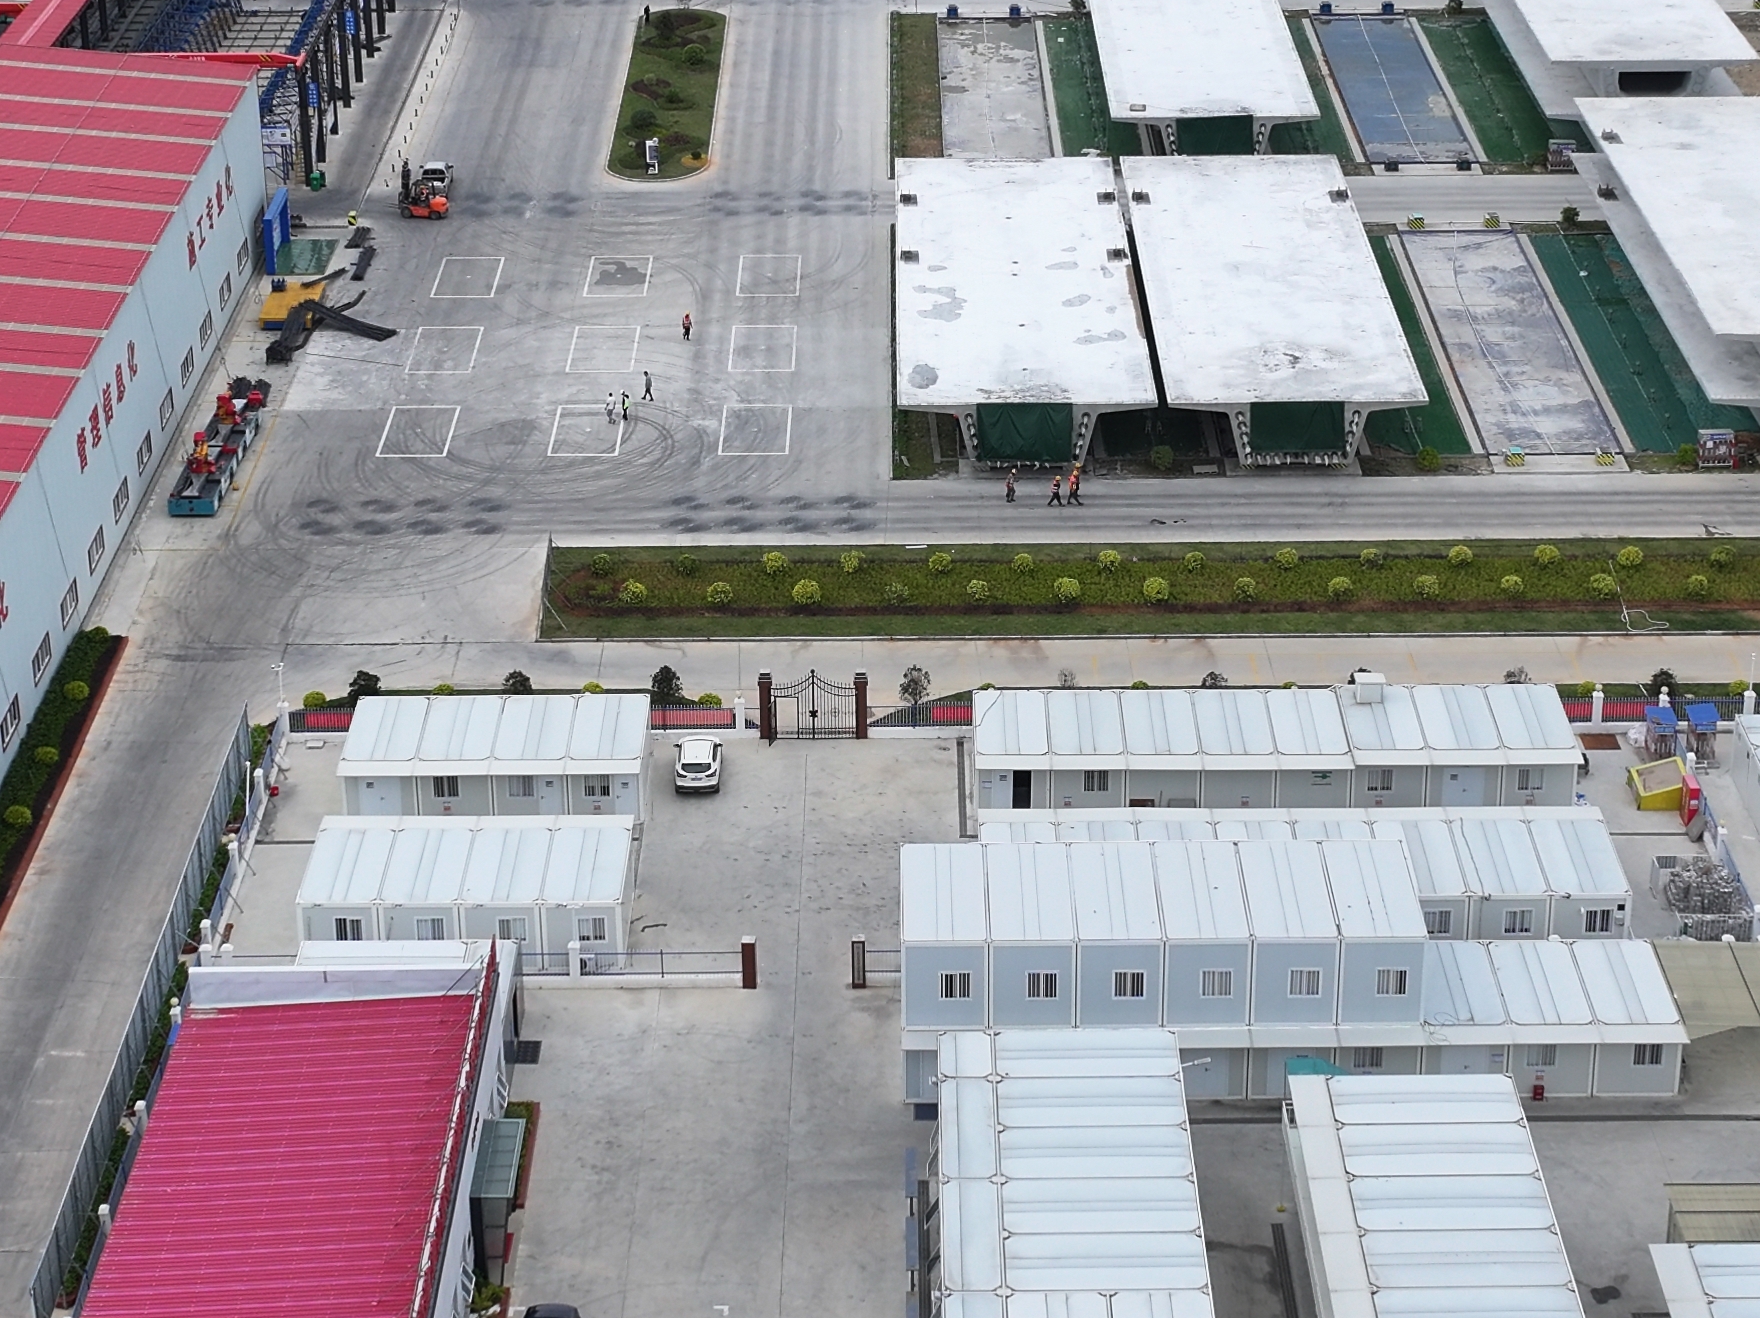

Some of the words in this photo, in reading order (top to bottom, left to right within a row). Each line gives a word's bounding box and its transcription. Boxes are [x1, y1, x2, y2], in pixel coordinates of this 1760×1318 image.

[186, 163, 234, 271] 施工专业化
[76, 339, 140, 474] 管理信息化
